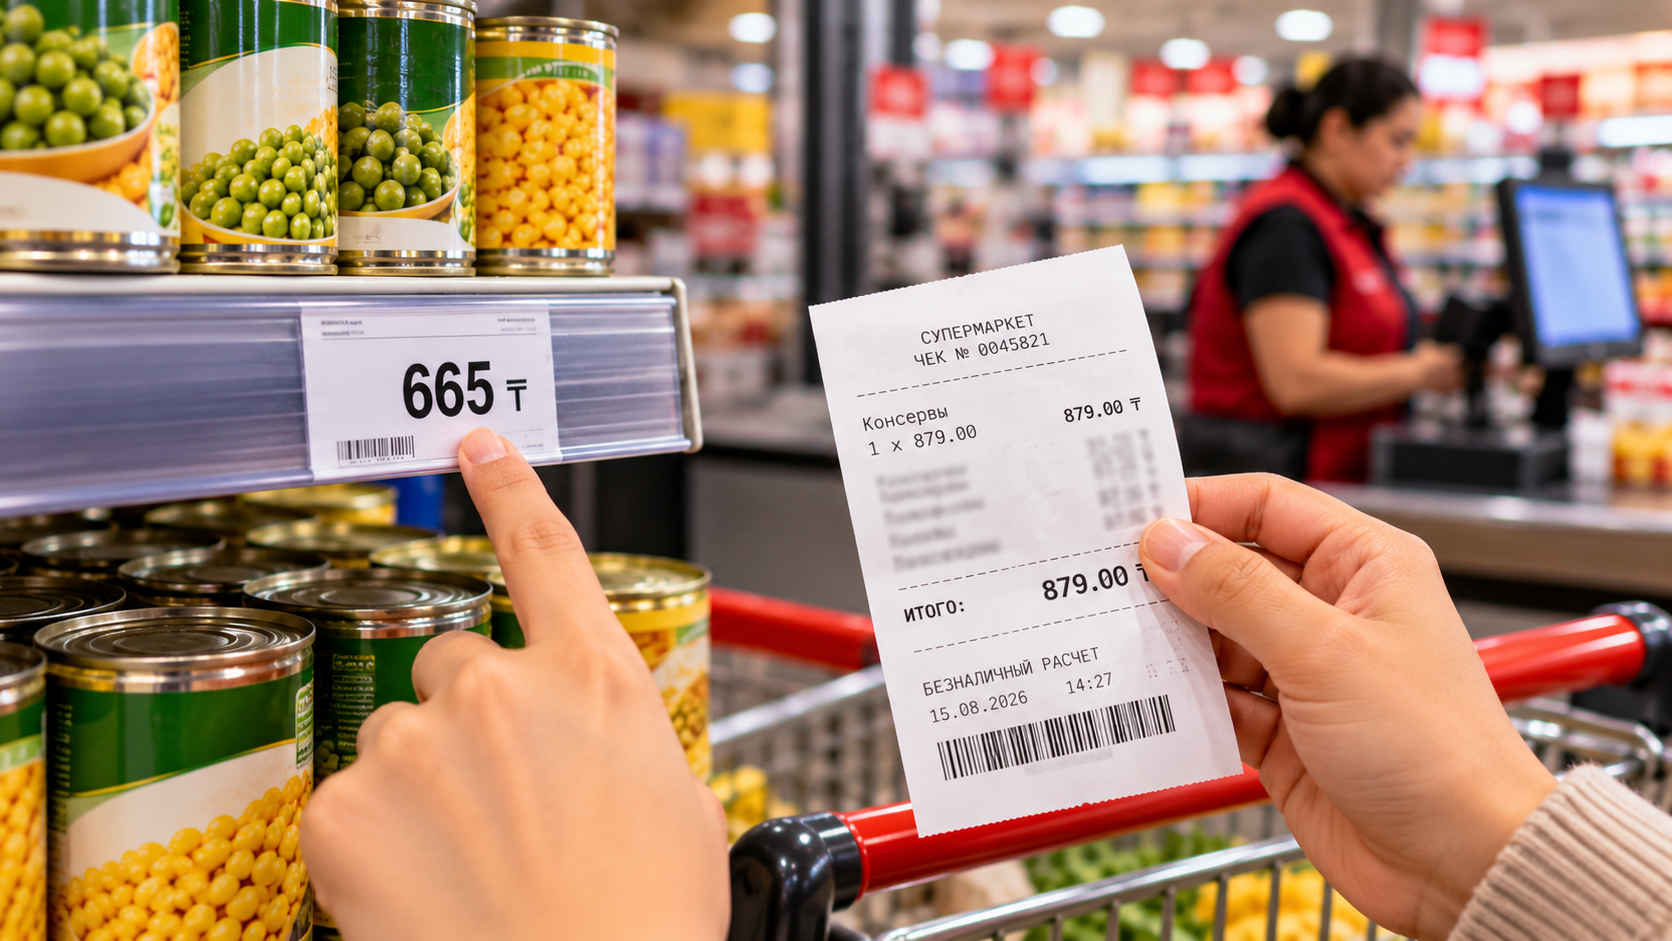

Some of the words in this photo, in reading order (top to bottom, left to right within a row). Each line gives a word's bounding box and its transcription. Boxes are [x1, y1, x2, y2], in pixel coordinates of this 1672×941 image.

[919, 313, 1035, 346] СУПЕРМАРКЕТ
[913, 349, 947, 368] ЧЕК
[954, 345, 971, 362] №
[977, 332, 1051, 358] 0045821
[402, 360, 495, 420] 665
[505, 377, 529, 412] ₸
[862, 405, 950, 433] Консервы
[1063, 398, 1125, 424] 879.00
[868, 440, 880, 457] 1
[912, 424, 978, 449] 879.00
[902, 598, 967, 624] ИТОГО:
[1041, 564, 1130, 602] 879.00
[921, 658, 1035, 698] БЕЗНАЛИЧНЫЙ
[1040, 645, 1101, 672] РАСЧЕТ
[928, 688, 1030, 725] 15.08.2026
[1065, 670, 1115, 696] 14:27
